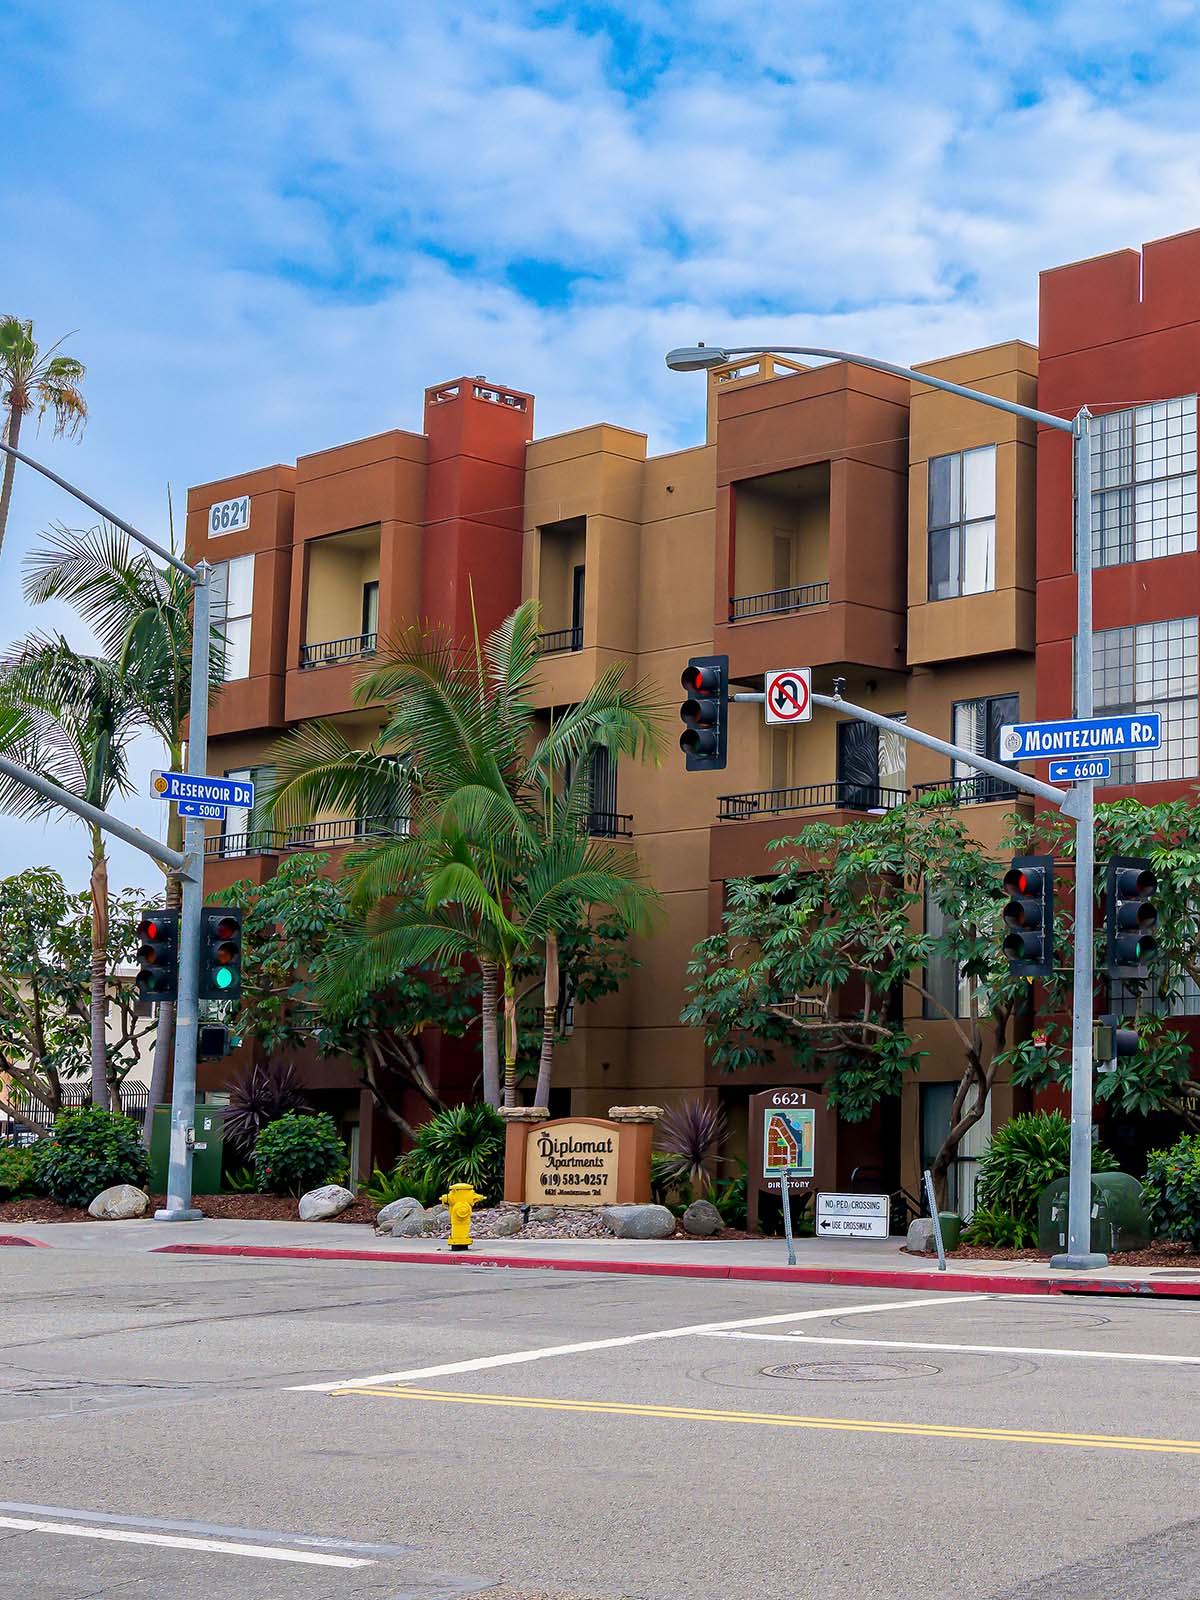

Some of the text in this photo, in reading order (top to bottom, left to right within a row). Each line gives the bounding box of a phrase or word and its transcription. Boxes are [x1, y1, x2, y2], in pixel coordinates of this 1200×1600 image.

[212, 499, 248, 531] 6621
[1074, 763, 1104, 778] 6600
[199, 804, 220, 816] 5000
[772, 1092, 807, 1105] 6621
[537, 1136, 613, 1158] Diplomat
[545, 1156, 604, 1170] Apartments
[540, 1172, 608, 1186] (619) 583-0257
[767, 1181, 810, 1189] DIRCTORY
[825, 1200, 881, 1210] NO PED CROSSING
[831, 1221, 873, 1231] USE CROSSWALK
